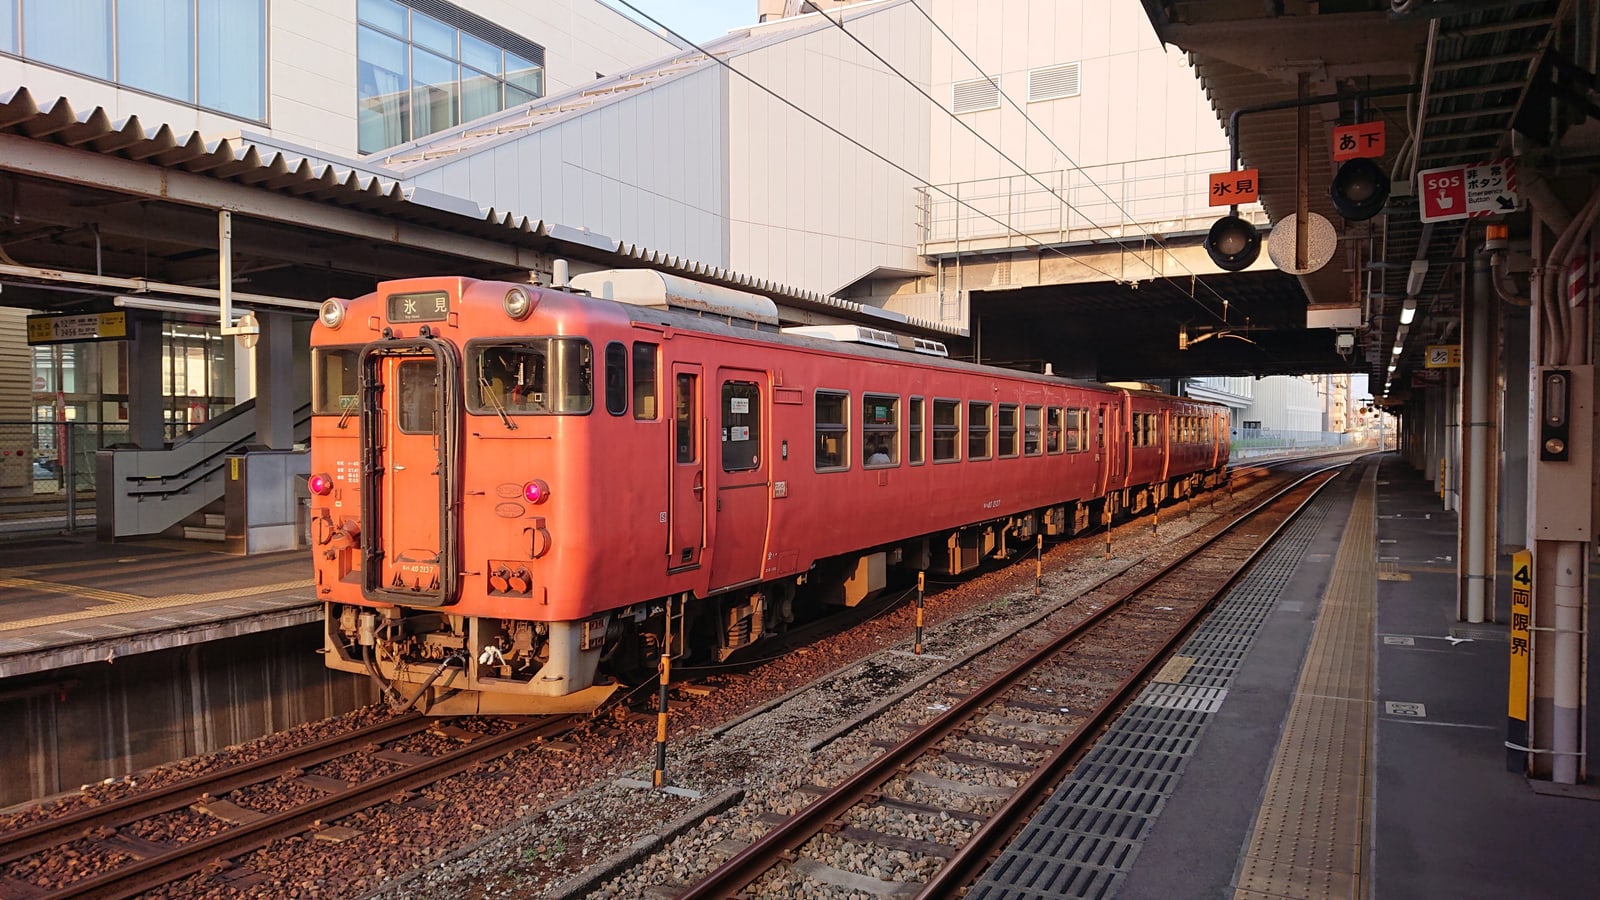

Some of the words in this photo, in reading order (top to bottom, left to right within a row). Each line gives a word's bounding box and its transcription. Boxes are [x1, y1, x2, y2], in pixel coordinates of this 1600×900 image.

[1339, 132, 1381, 151] あ下
[1212, 179, 1255, 197] 氷見
[1428, 175, 1460, 190] SOS
[1468, 177, 1503, 189] ボタン
[1468, 189, 1503, 198] Emergency
[1468, 196, 1491, 204] Button
[404, 297, 447, 314] 氷見
[1511, 565, 1531, 656] 4両限界
